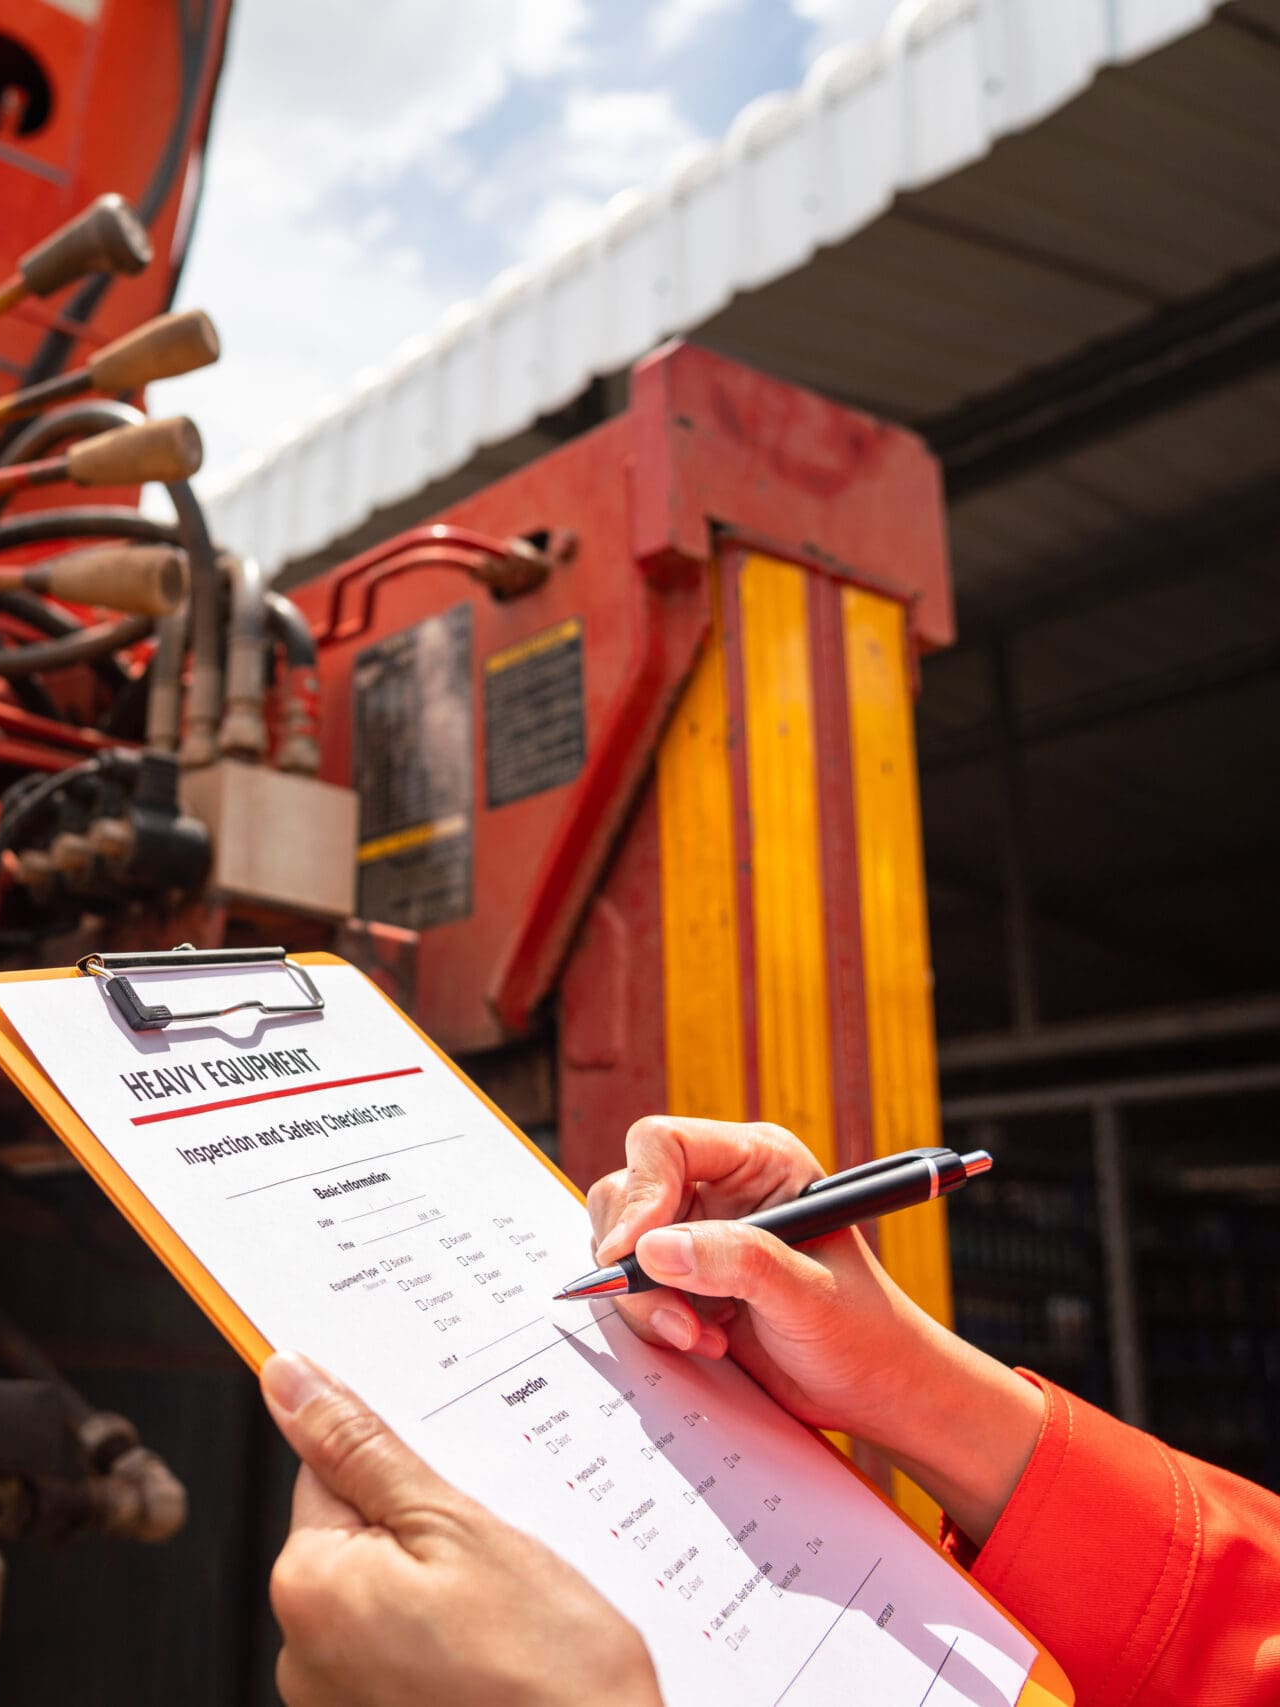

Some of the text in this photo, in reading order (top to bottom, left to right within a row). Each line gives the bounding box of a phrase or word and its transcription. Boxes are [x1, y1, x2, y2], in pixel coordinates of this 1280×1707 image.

[120, 1048, 320, 1101] HEAVY EQUIPMENT
[176, 1102, 407, 1165] Inspection and Safety Checklist Form
[312, 1172, 391, 1200] Basic Information
[317, 1218, 335, 1229] Date
[337, 1241, 356, 1251] Time
[329, 1273, 365, 1292] Equipment
[362, 1267, 379, 1279] Type
[425, 1291, 454, 1307] Compactor
[439, 1356, 455, 1369] Unit
[501, 1376, 548, 1407] Inspection
[546, 1420, 553, 1429] or
[550, 1410, 570, 1423] Tracks
[575, 1462, 601, 1483] Hydraulic
[618, 1498, 656, 1529] Hose Condition
[663, 1567, 675, 1580] Oil
[673, 1559, 685, 1573] Leak
[686, 1546, 699, 1561] Lube
[735, 1588, 749, 1602] Seat
[743, 1579, 756, 1593] Belt
[753, 1571, 764, 1584] and
